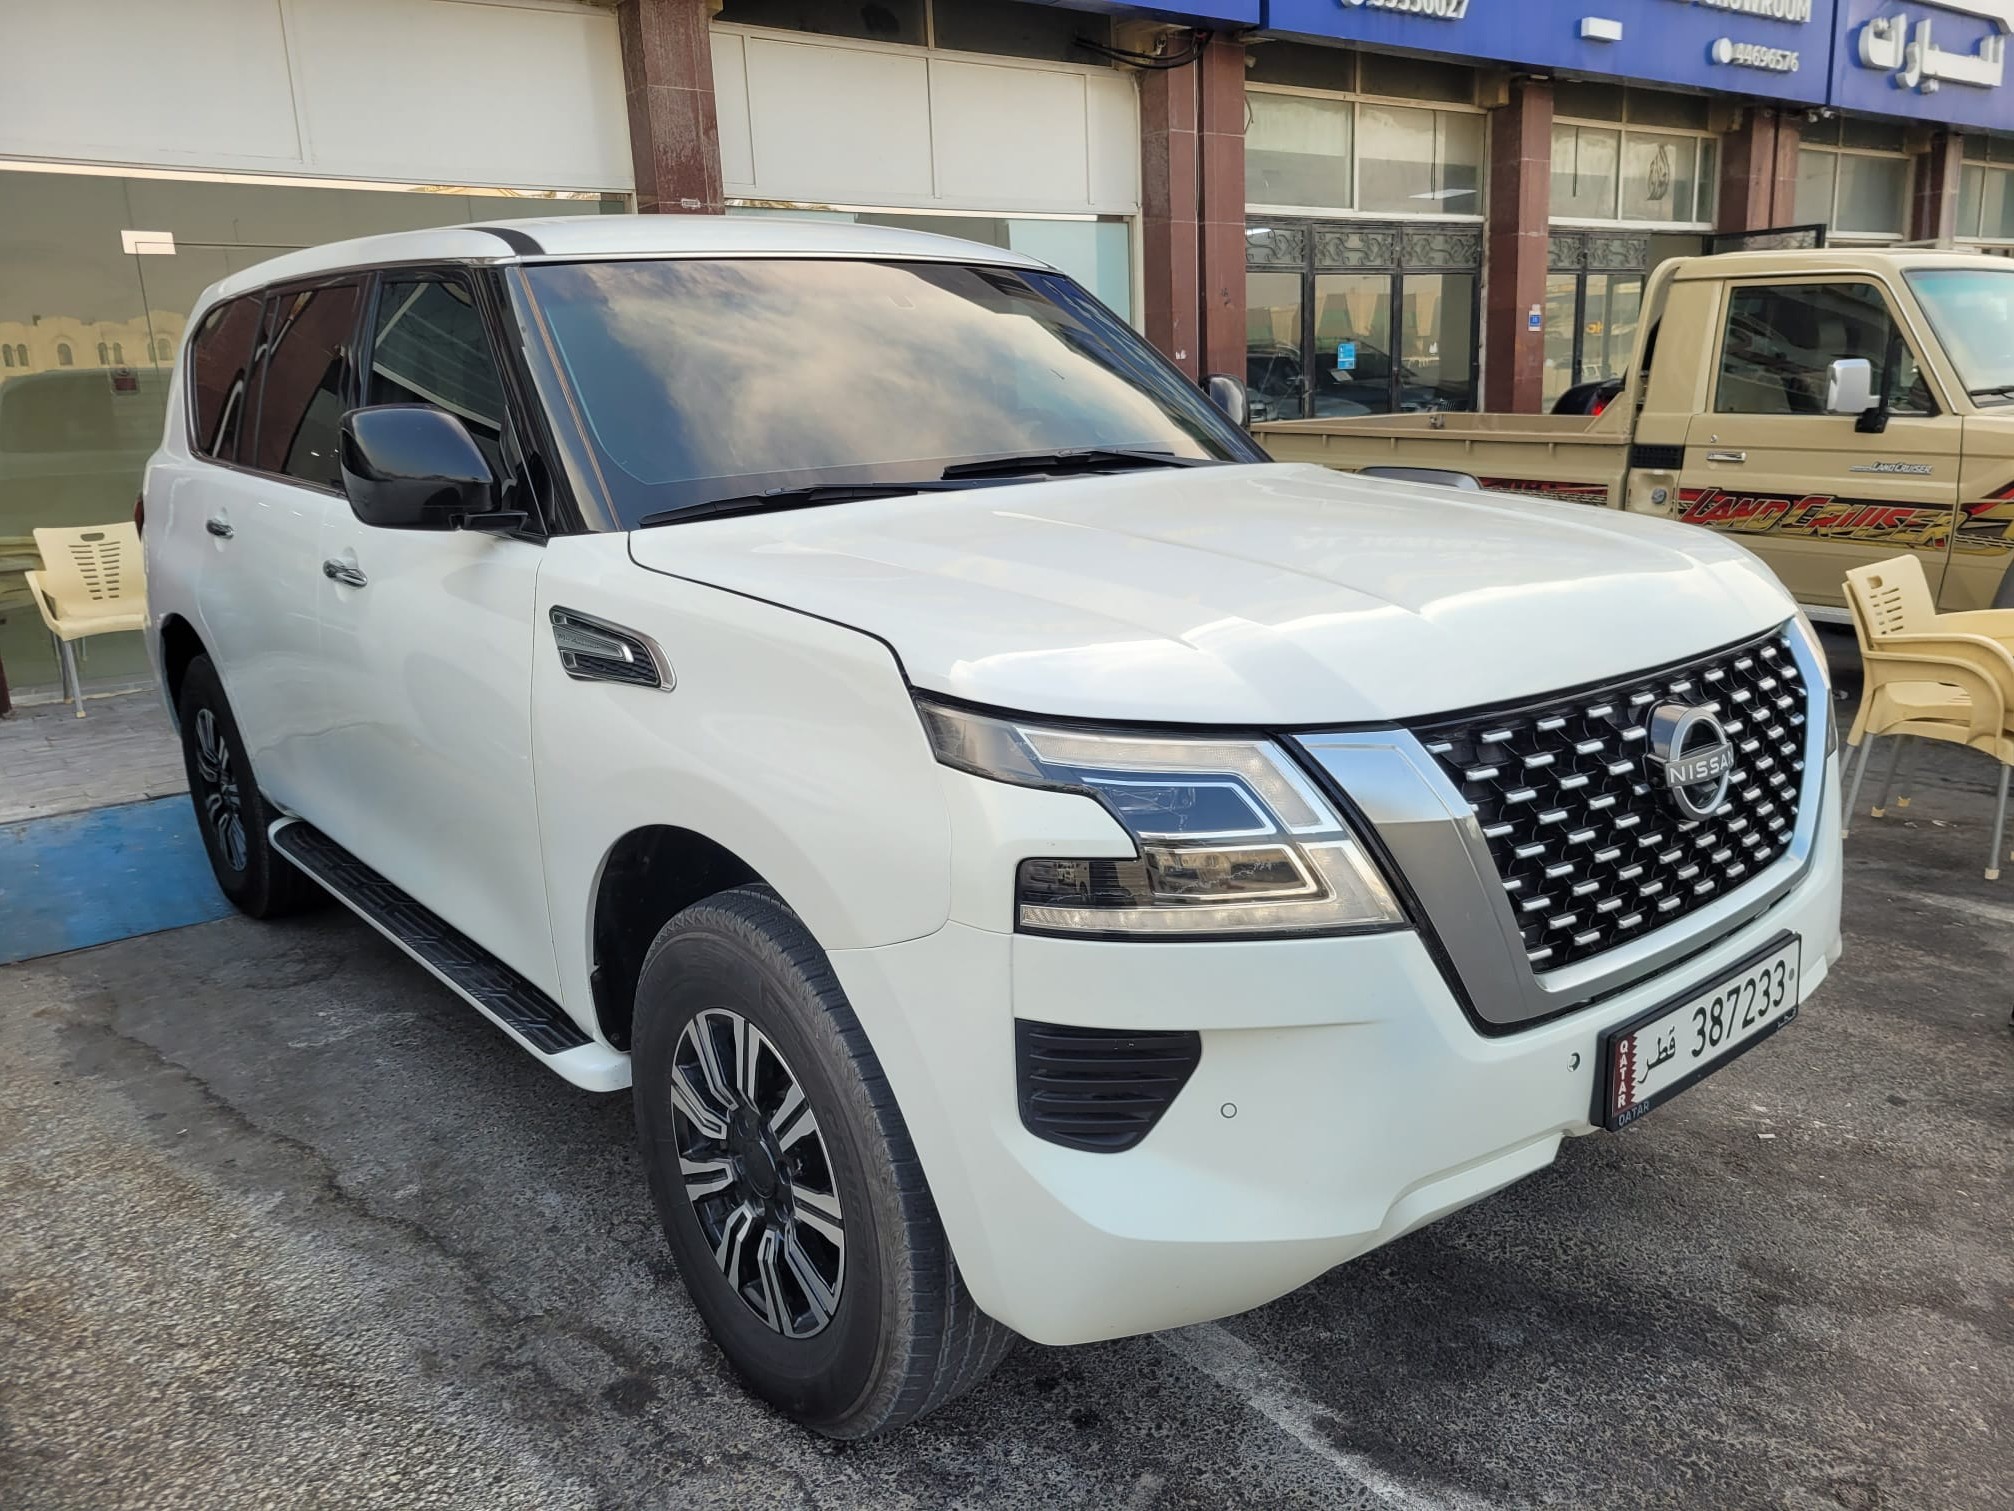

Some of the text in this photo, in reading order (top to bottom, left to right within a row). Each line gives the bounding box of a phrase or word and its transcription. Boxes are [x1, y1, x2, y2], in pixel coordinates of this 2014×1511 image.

[1679, 487, 1969, 548] LAND CRUISER
[1669, 749, 1735, 784] NISSAN
[1691, 959, 1786, 1057] 387233
[1617, 1039, 1629, 1109] QATAR
[1637, 1025, 1676, 1084] قطر
[1618, 1101, 1651, 1128] QATAR
